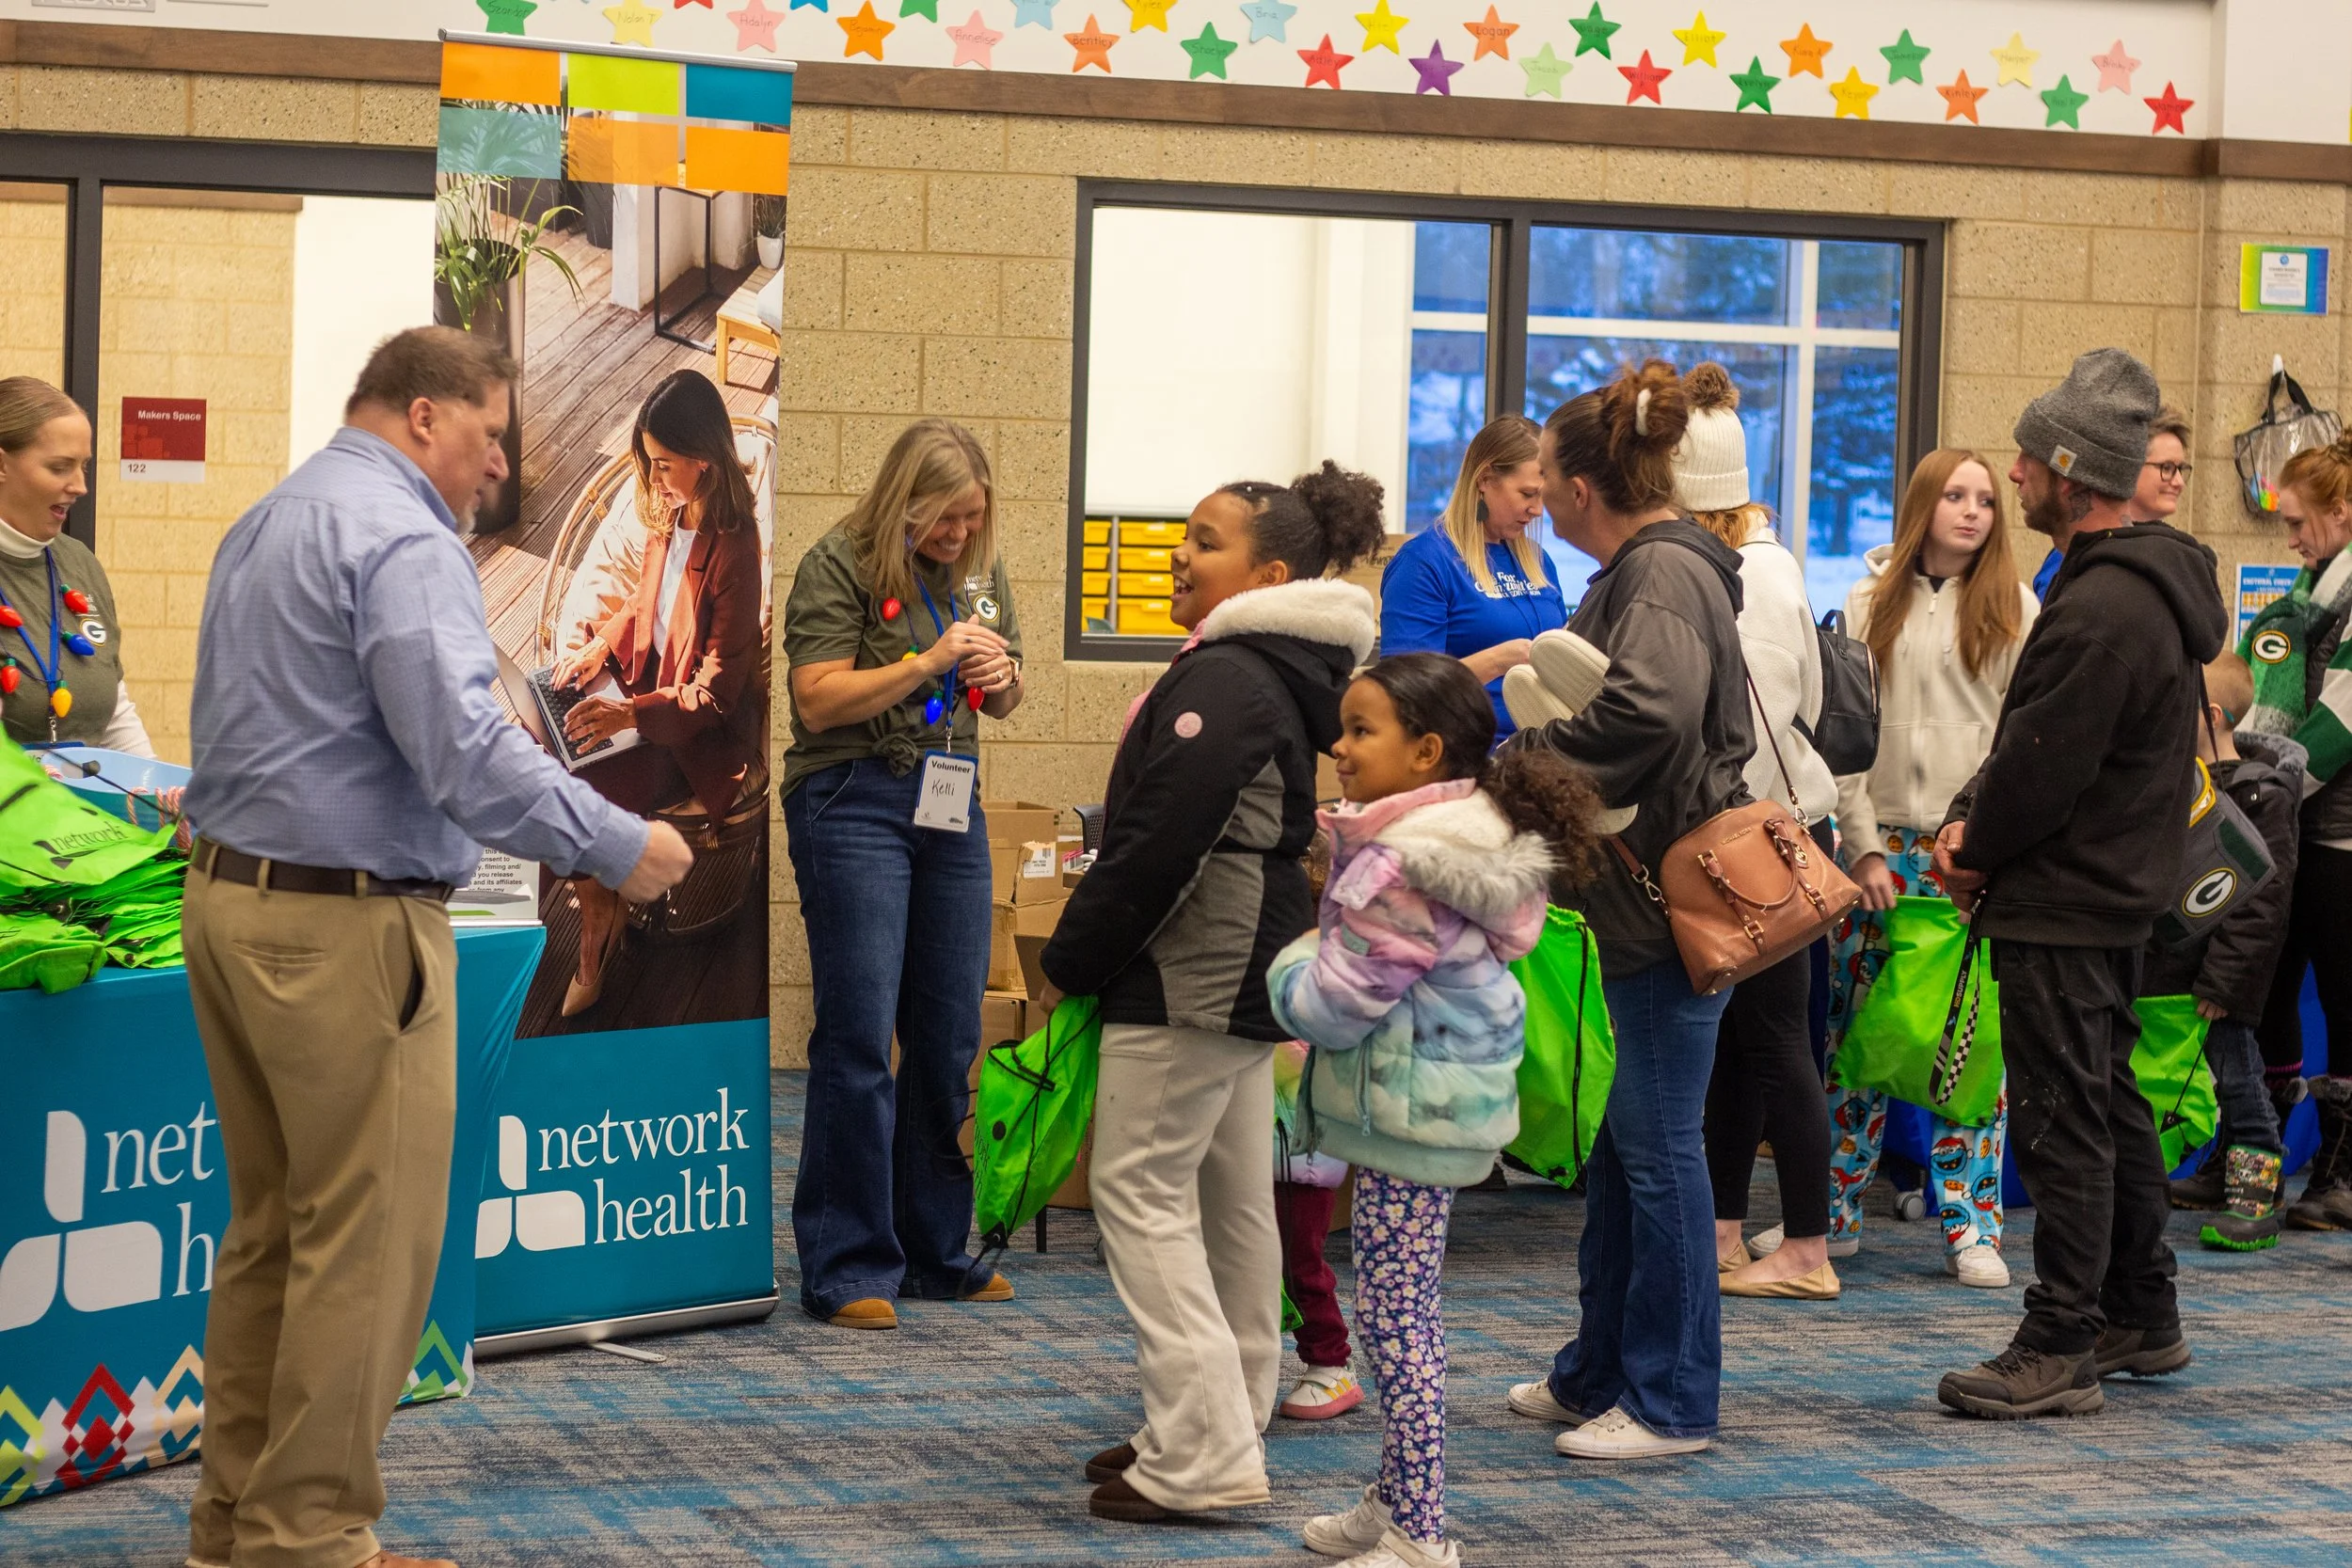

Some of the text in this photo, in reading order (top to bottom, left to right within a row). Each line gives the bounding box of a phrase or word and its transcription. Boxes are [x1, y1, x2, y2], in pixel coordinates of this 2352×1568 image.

[617, 10, 644, 24] Nolan
[739, 14, 773, 33] Adalyn
[955, 29, 996, 46] Annelise
[1476, 25, 1510, 40] Logan
[1073, 35, 1113, 49] Bentley
[137, 409, 202, 421] Makers Space
[128, 463, 147, 473] 122
[931, 760, 971, 774] Volunteer
[931, 779, 956, 799] Kelli
[52, 821, 129, 850] network
[538, 1086, 751, 1172] network
[100, 1101, 222, 1195] net
[593, 1164, 750, 1244] health
